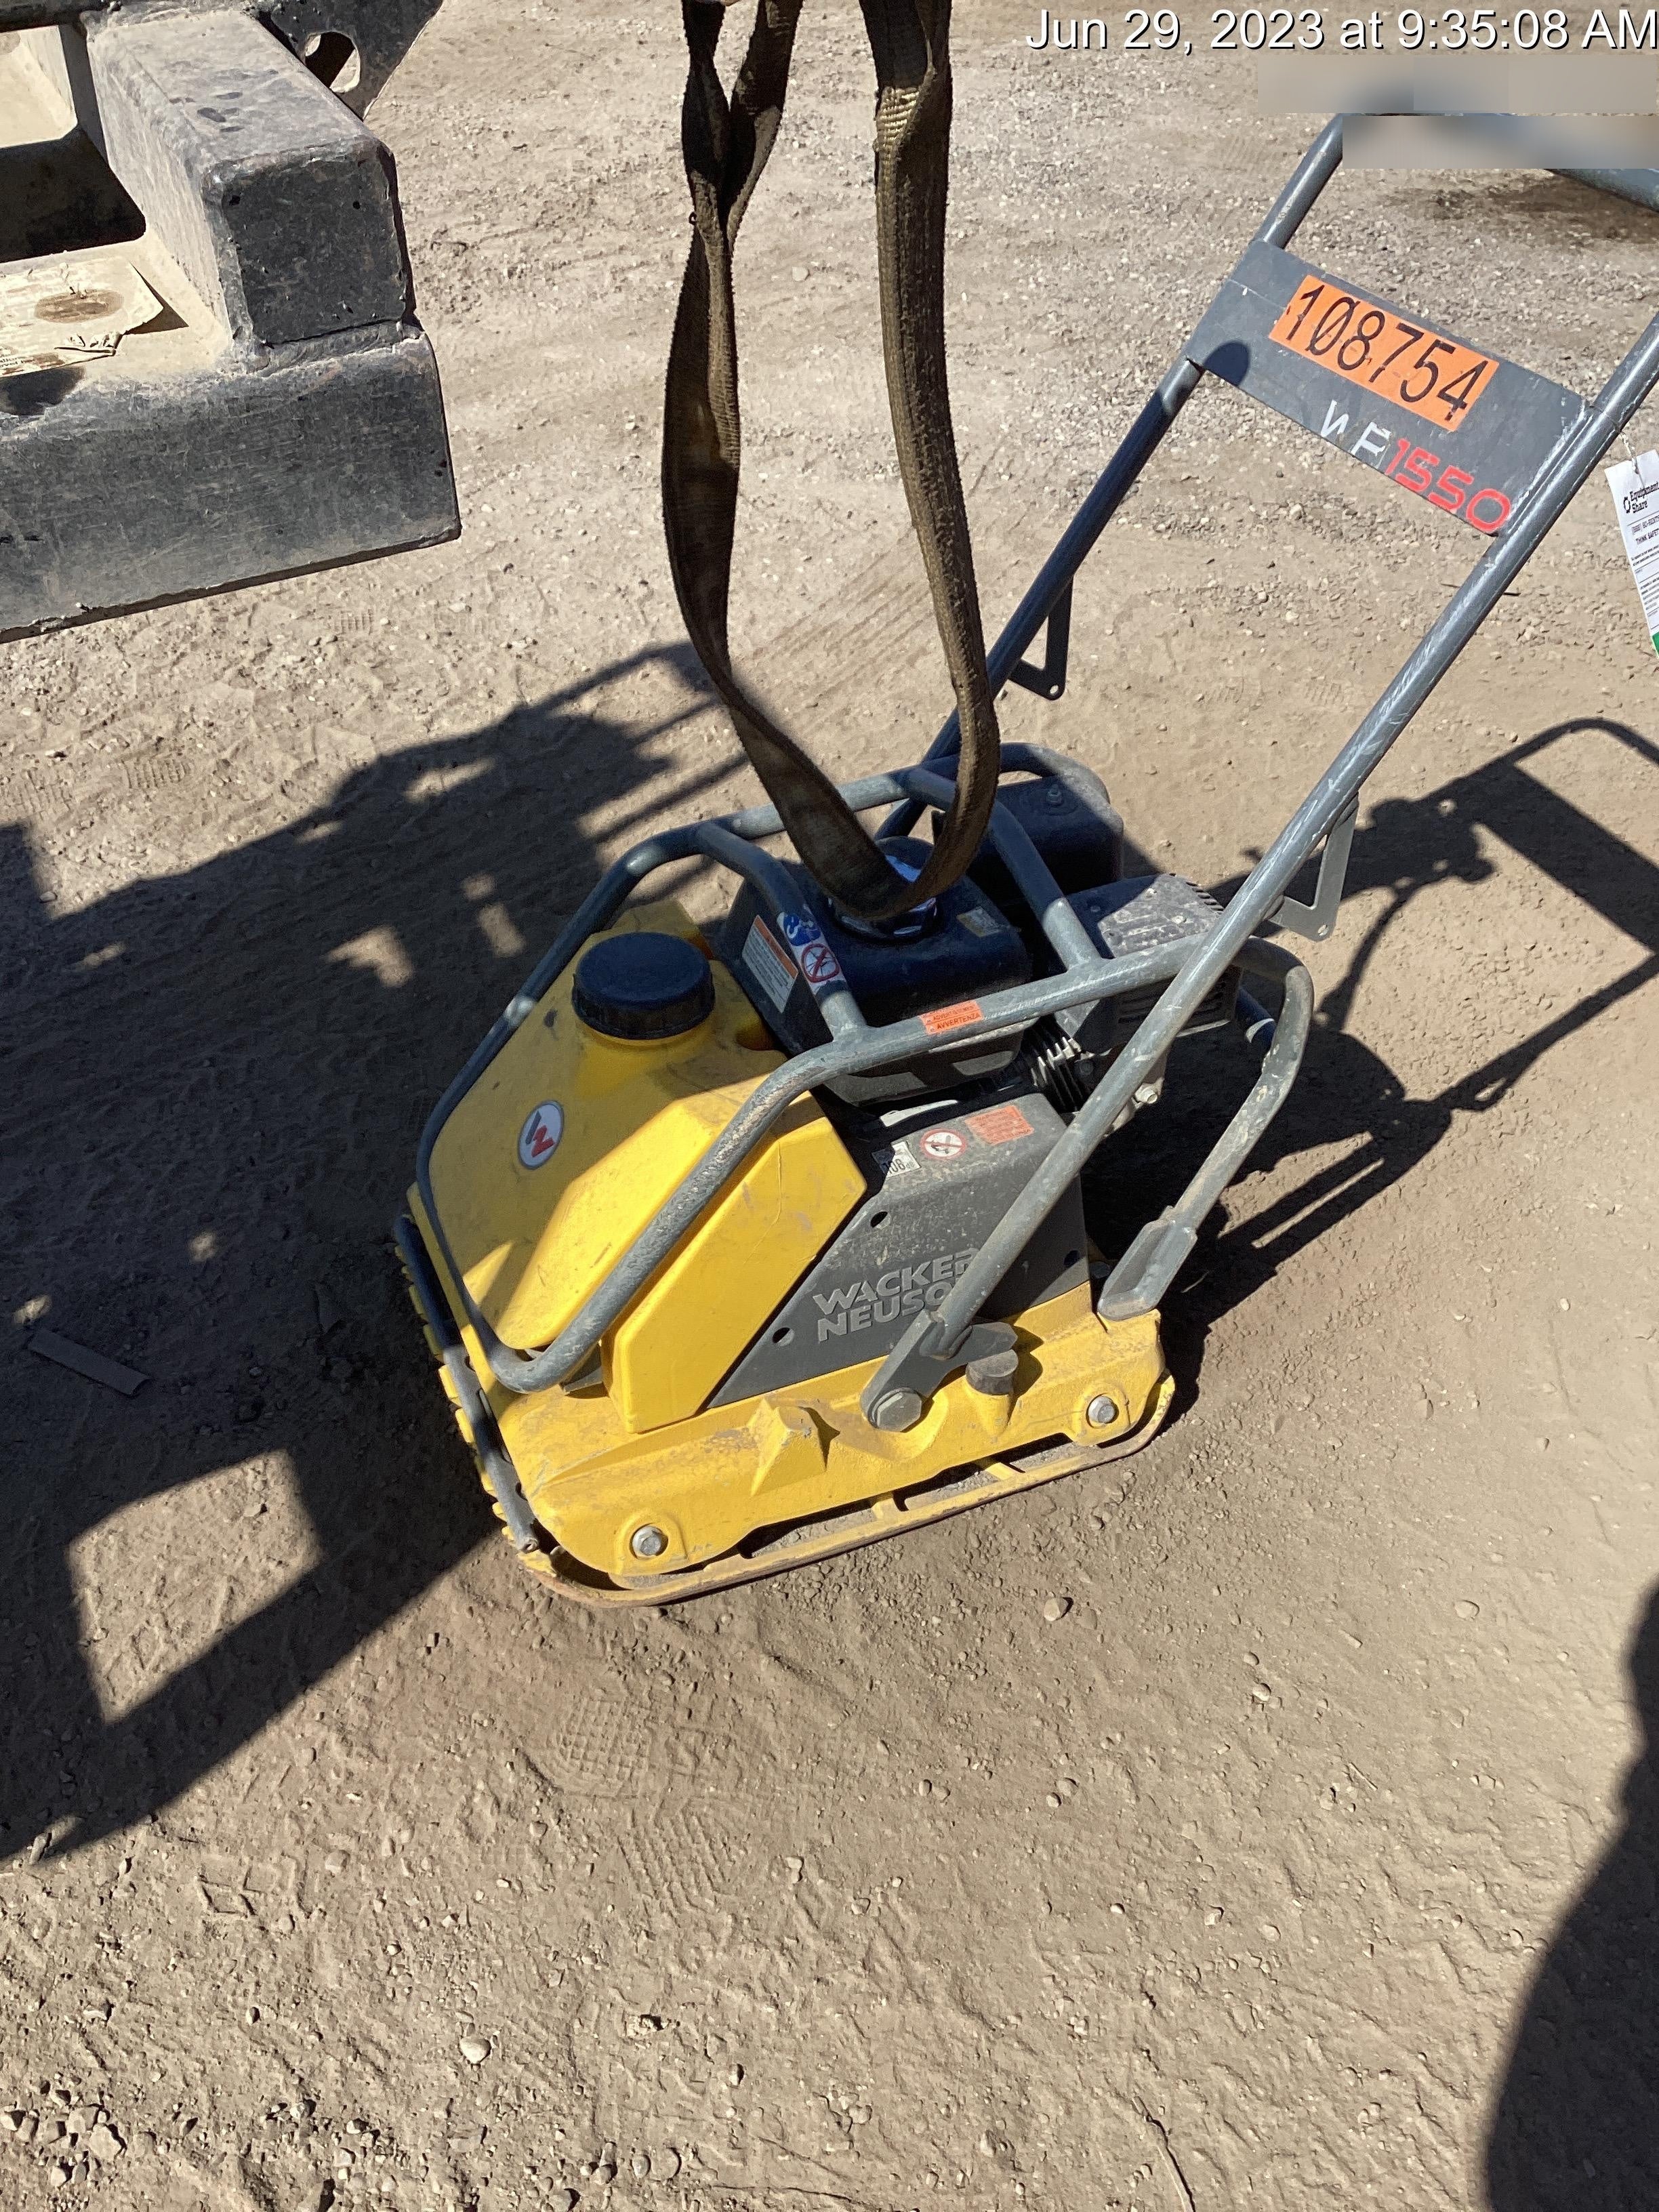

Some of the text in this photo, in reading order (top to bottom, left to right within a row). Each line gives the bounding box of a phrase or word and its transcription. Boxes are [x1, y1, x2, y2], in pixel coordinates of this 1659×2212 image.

[1286, 284, 1489, 422] 108754
[1632, 500, 1648, 514] Share
[813, 1247, 980, 1316] WACKER
[817, 1277, 962, 1343] NEUSO
